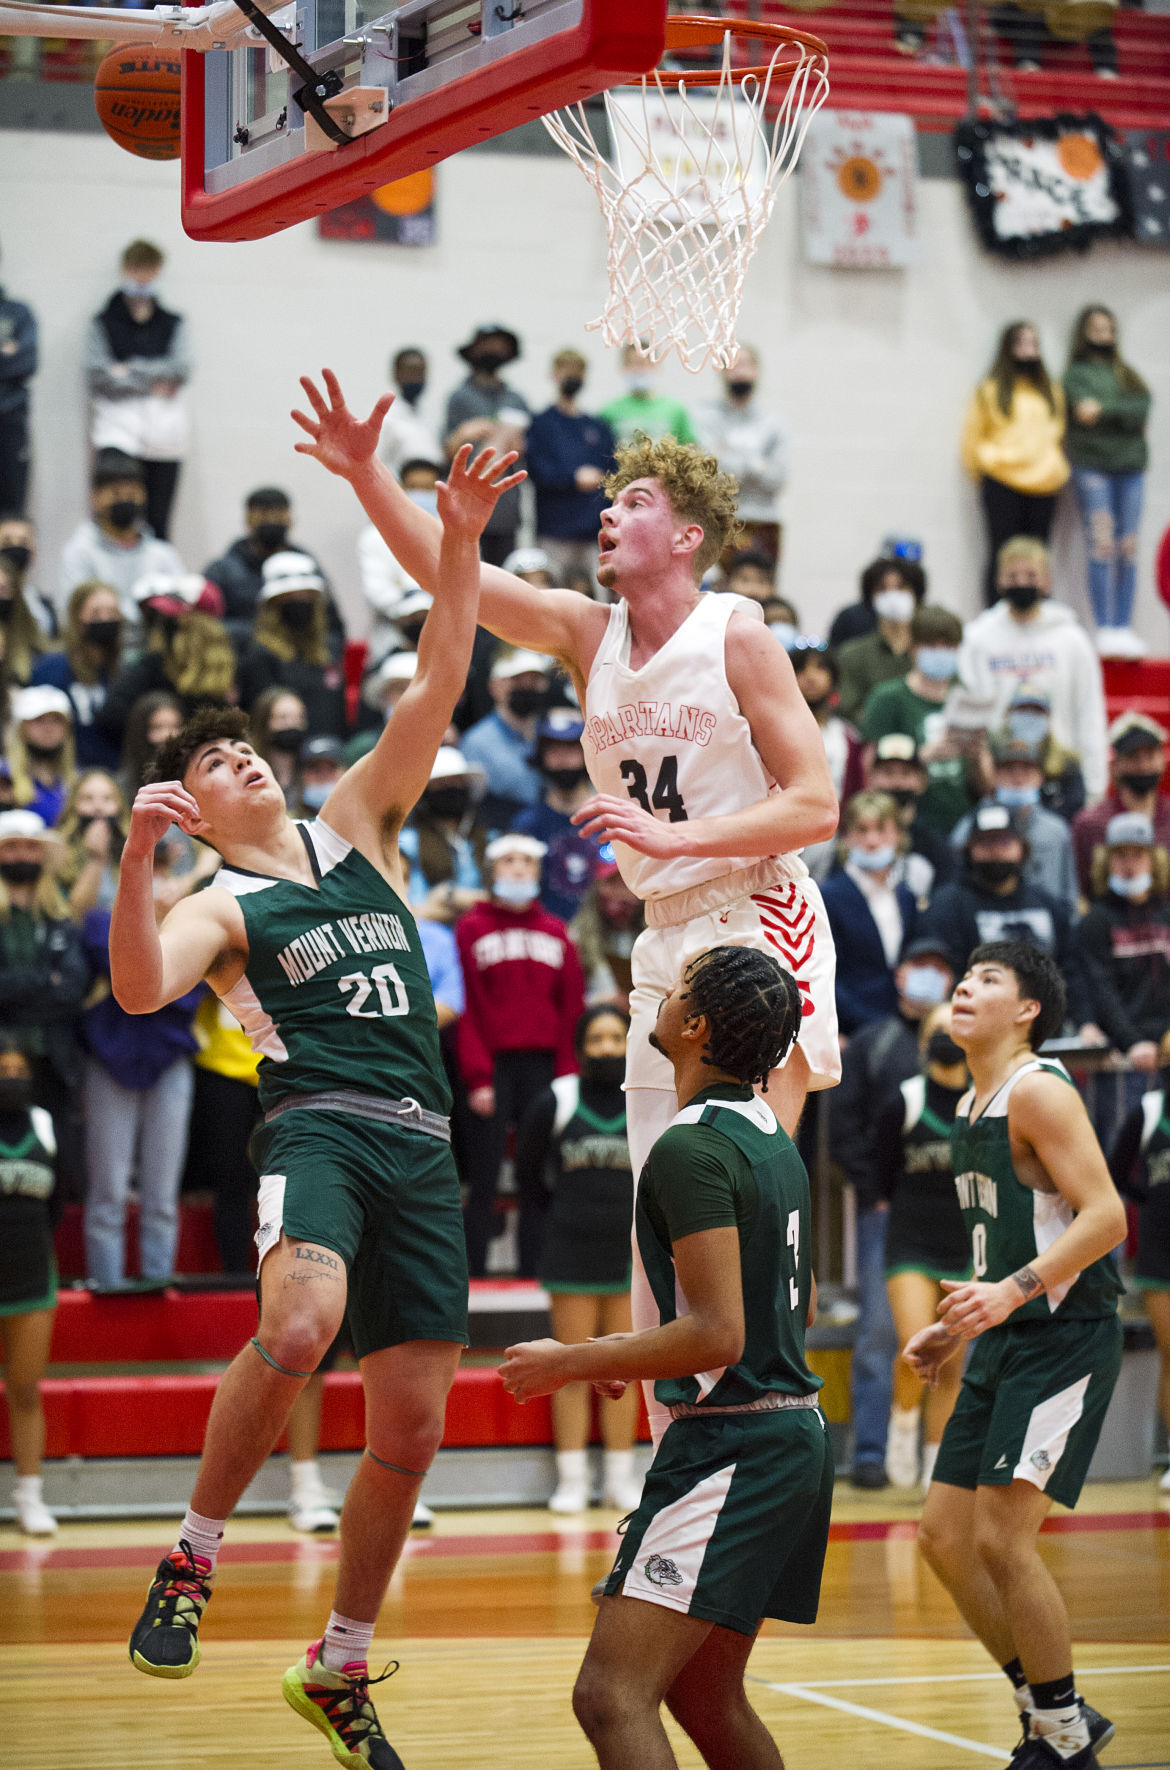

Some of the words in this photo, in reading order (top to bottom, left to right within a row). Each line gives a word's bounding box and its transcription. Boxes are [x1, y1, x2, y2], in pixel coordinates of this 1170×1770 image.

[619, 755, 689, 824] 34
[277, 922, 347, 988] MOUNT
[336, 912, 412, 954] VERNON
[337, 962, 410, 1019] 20
